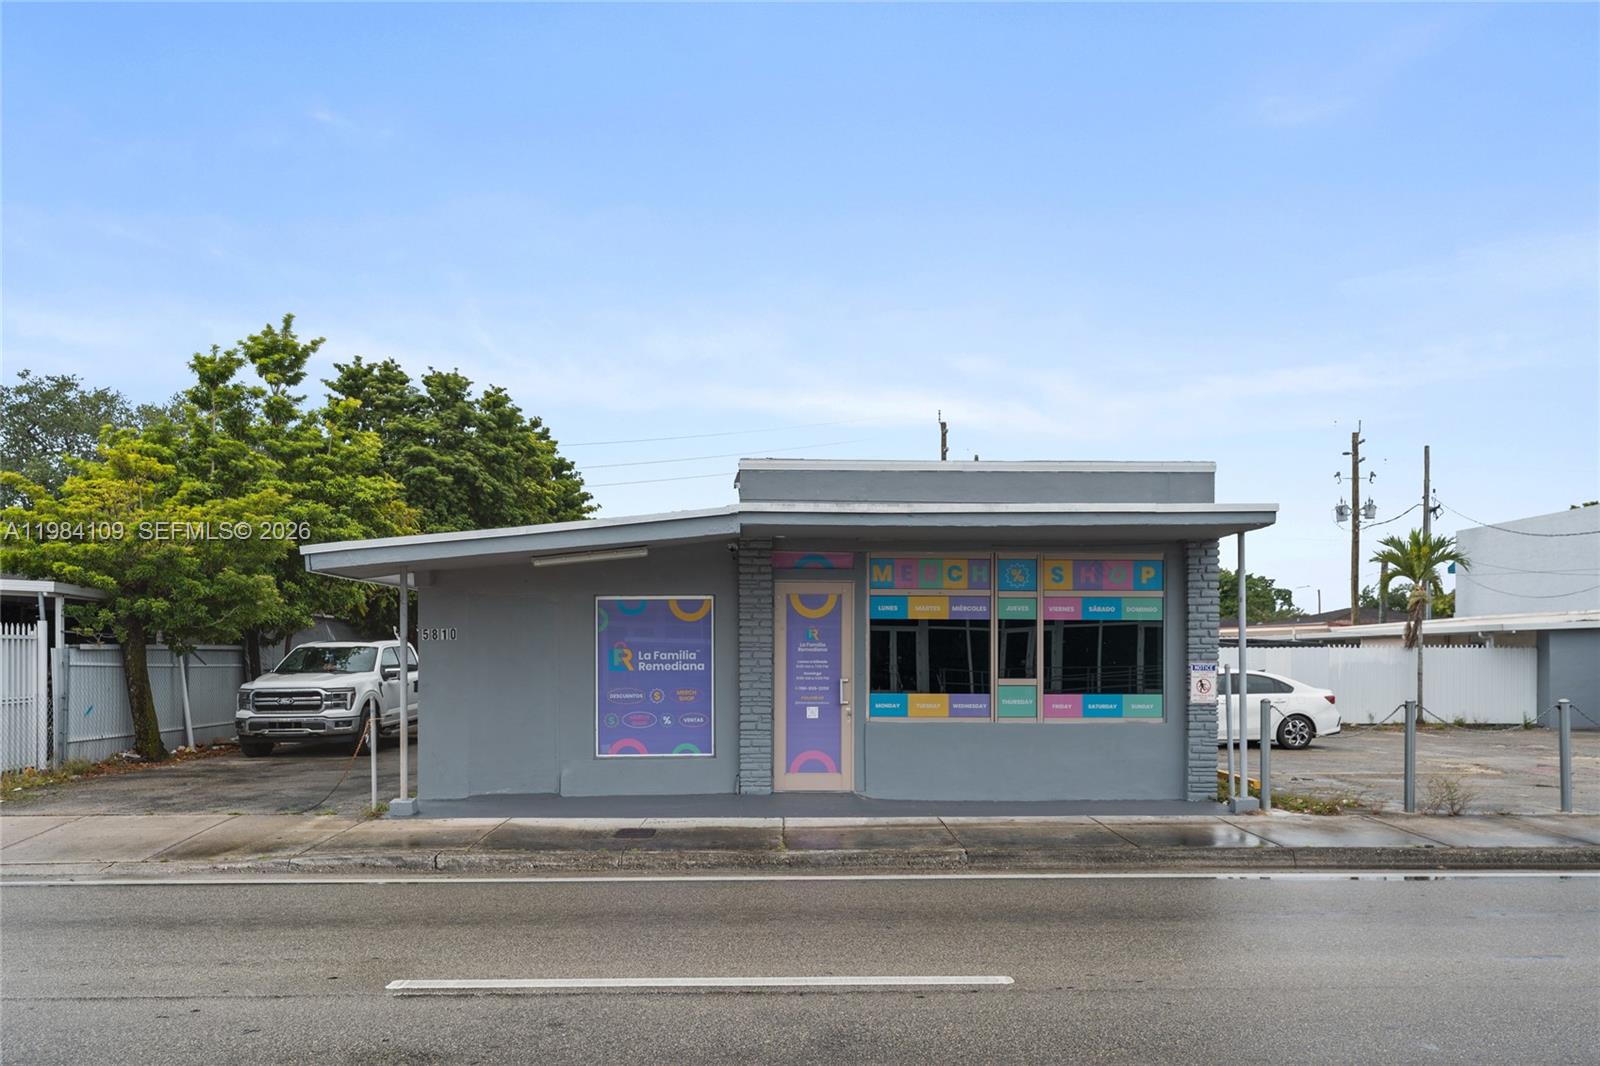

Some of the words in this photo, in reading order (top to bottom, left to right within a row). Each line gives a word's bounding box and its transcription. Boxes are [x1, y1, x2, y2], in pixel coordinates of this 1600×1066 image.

[1051, 565, 1156, 584] SHOP
[422, 628, 457, 640] 5810
[638, 651, 651, 660] La
[653, 650, 697, 660] Familia
[638, 661, 705, 671] Remediana
